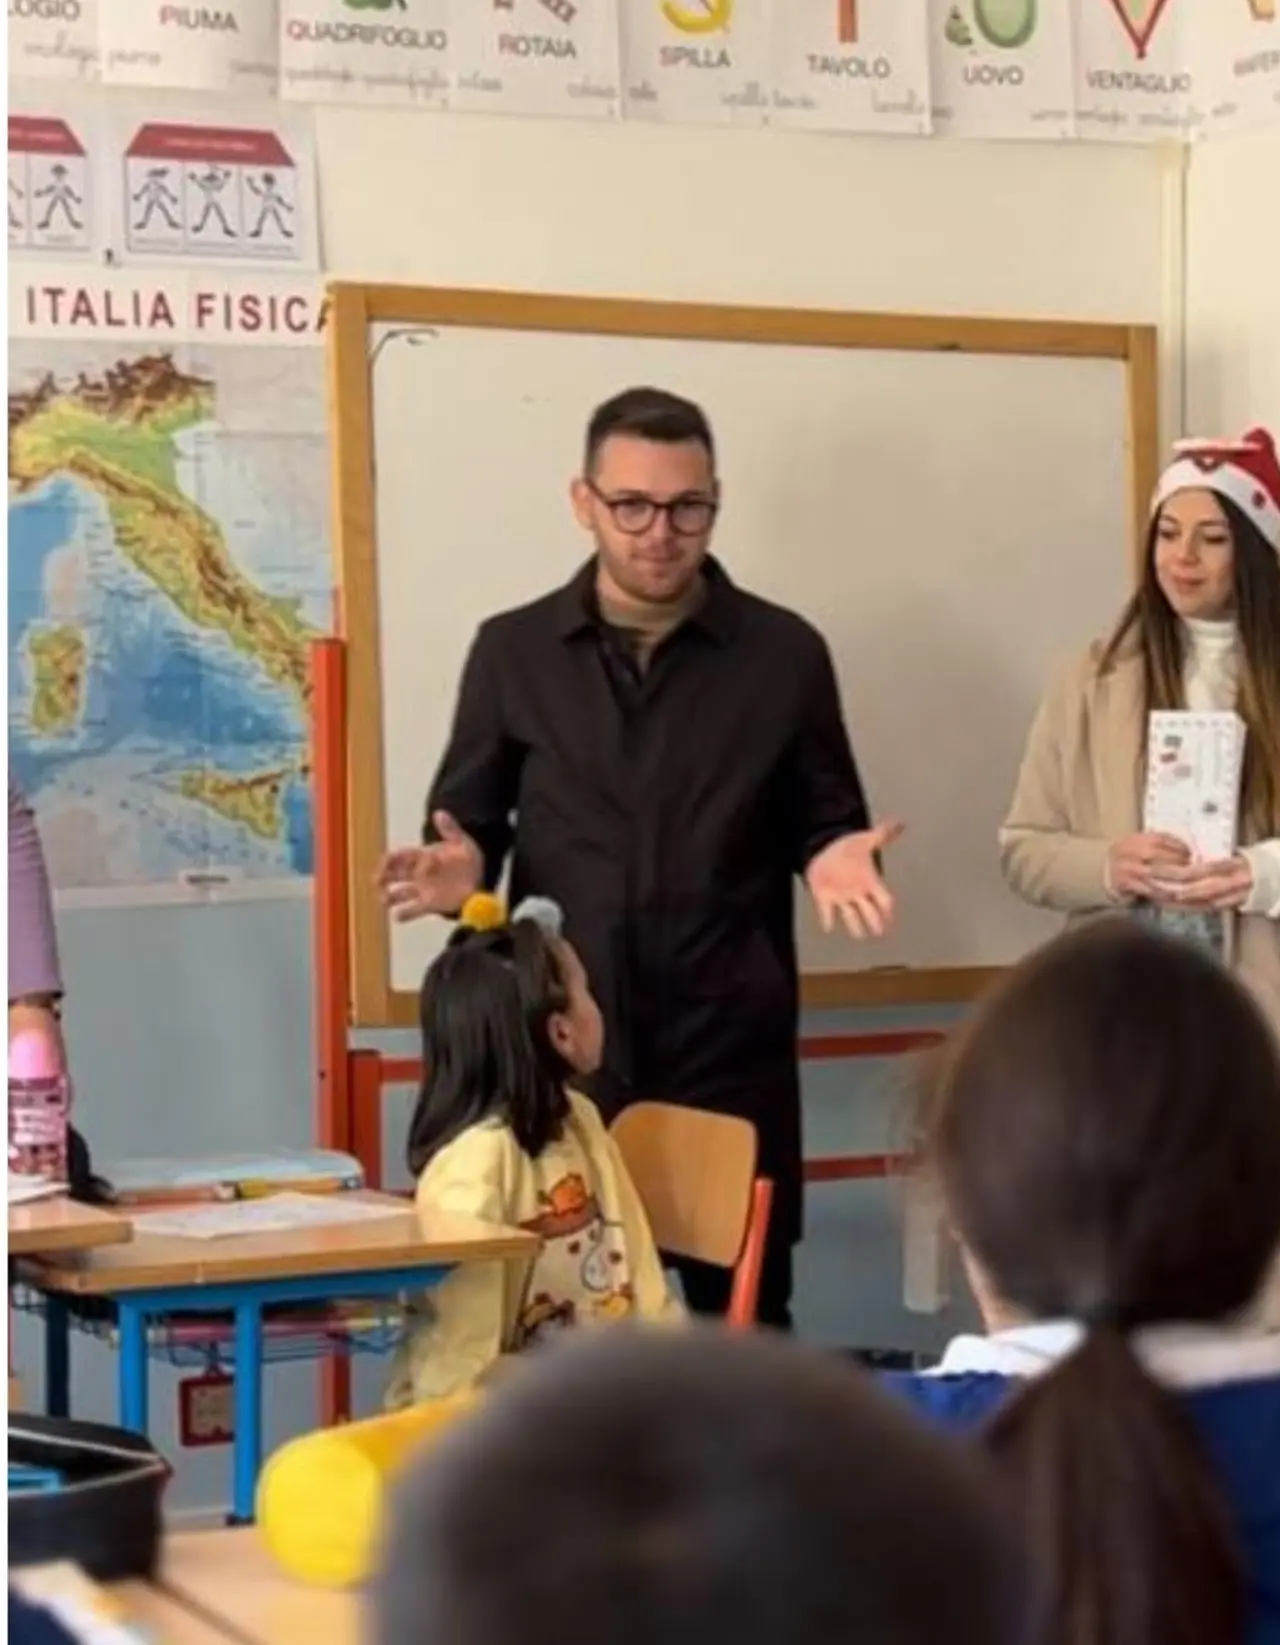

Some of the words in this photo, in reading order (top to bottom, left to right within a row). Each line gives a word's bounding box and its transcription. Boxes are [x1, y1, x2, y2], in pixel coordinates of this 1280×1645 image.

[8, 0, 81, 21] OGIO
[159, 5, 239, 32] PIUMA
[286, 20, 448, 51] QUADRIFOGLIO
[499, 33, 577, 59] ROTAIA
[660, 46, 731, 69] SPILLA
[807, 53, 891, 79] TAVOLO
[963, 64, 1025, 86] UOVO
[1086, 69, 1192, 93] VENTAGLIO
[26, 284, 175, 328] ITALIA
